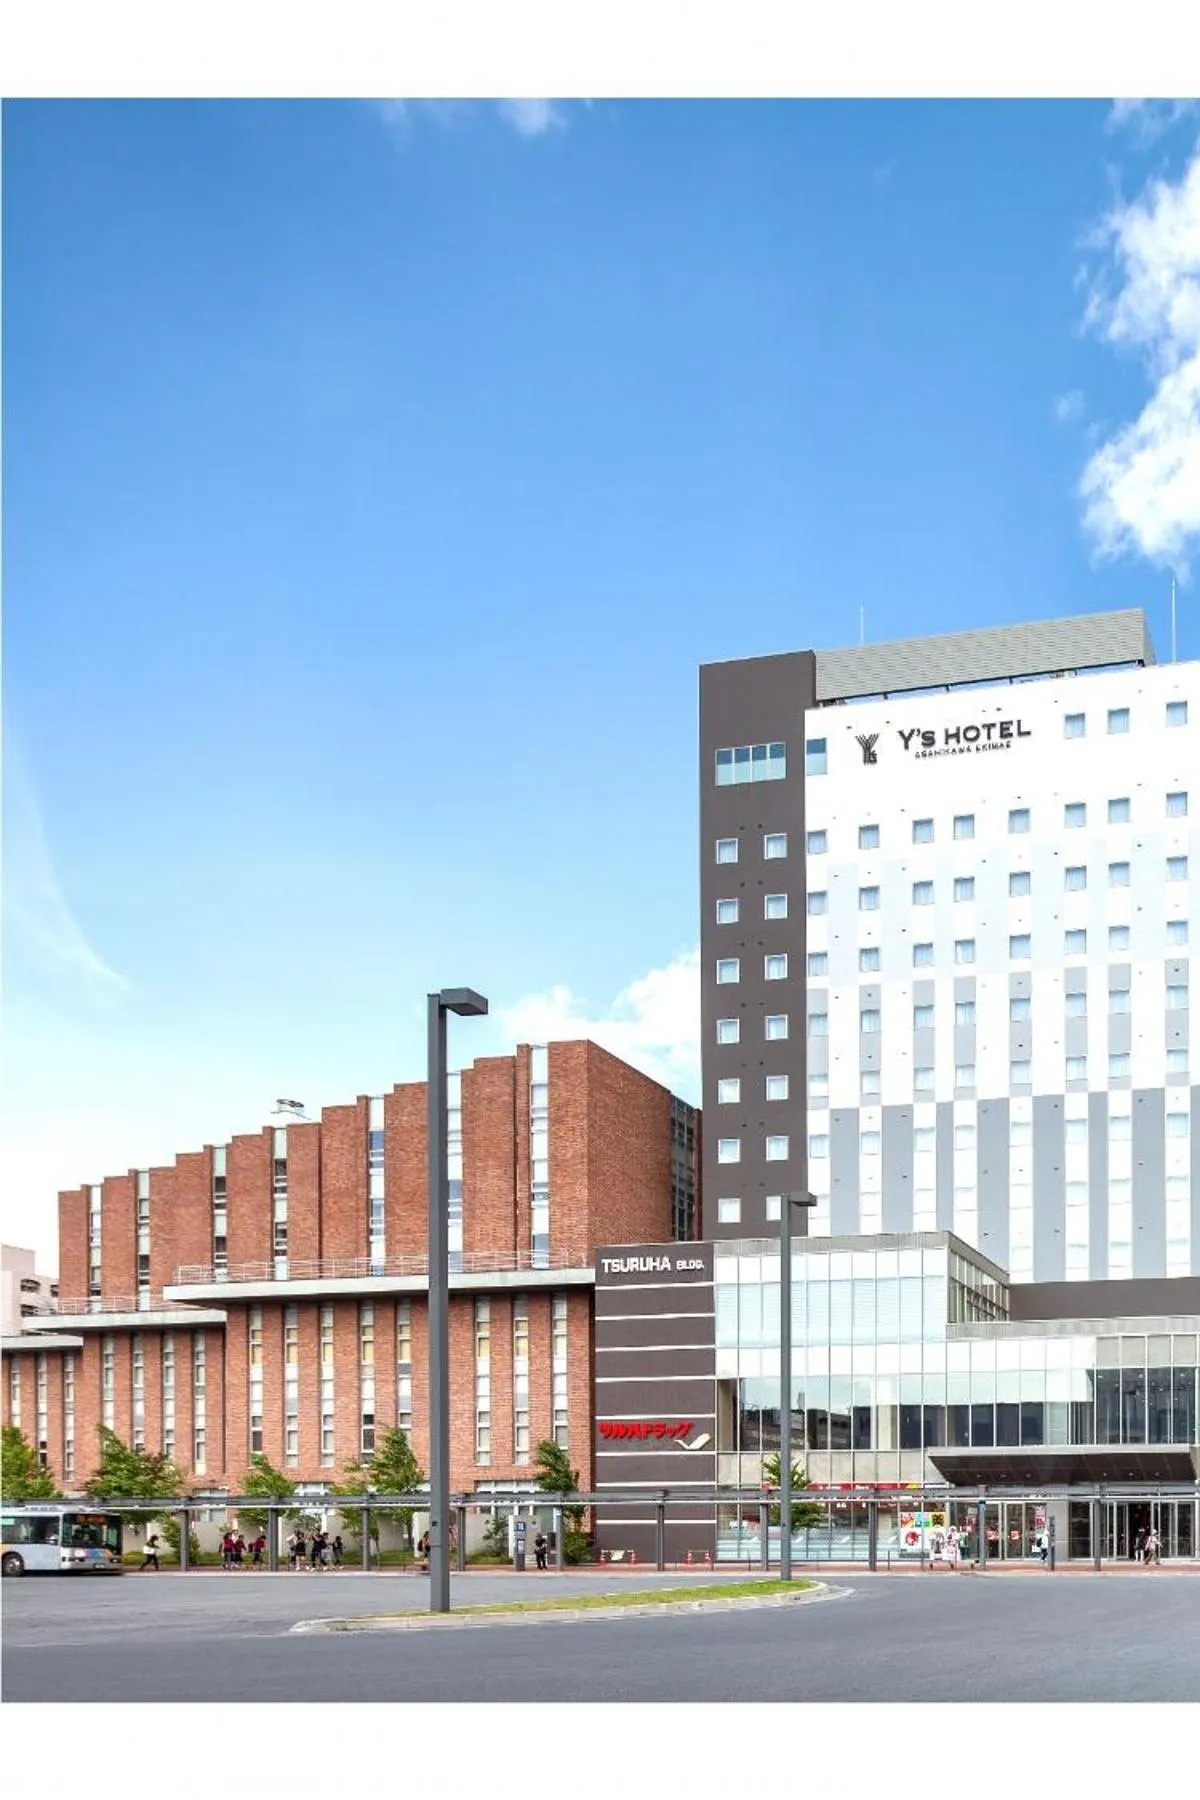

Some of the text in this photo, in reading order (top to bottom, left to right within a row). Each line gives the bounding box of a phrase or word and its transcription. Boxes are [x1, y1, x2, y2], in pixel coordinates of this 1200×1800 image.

[944, 719, 1032, 746] HOTEL
[975, 740, 1012, 754] EKIMAE
[601, 1256, 671, 1274] TSURUHA
[598, 1421, 695, 1440] ツルハドラッグ
